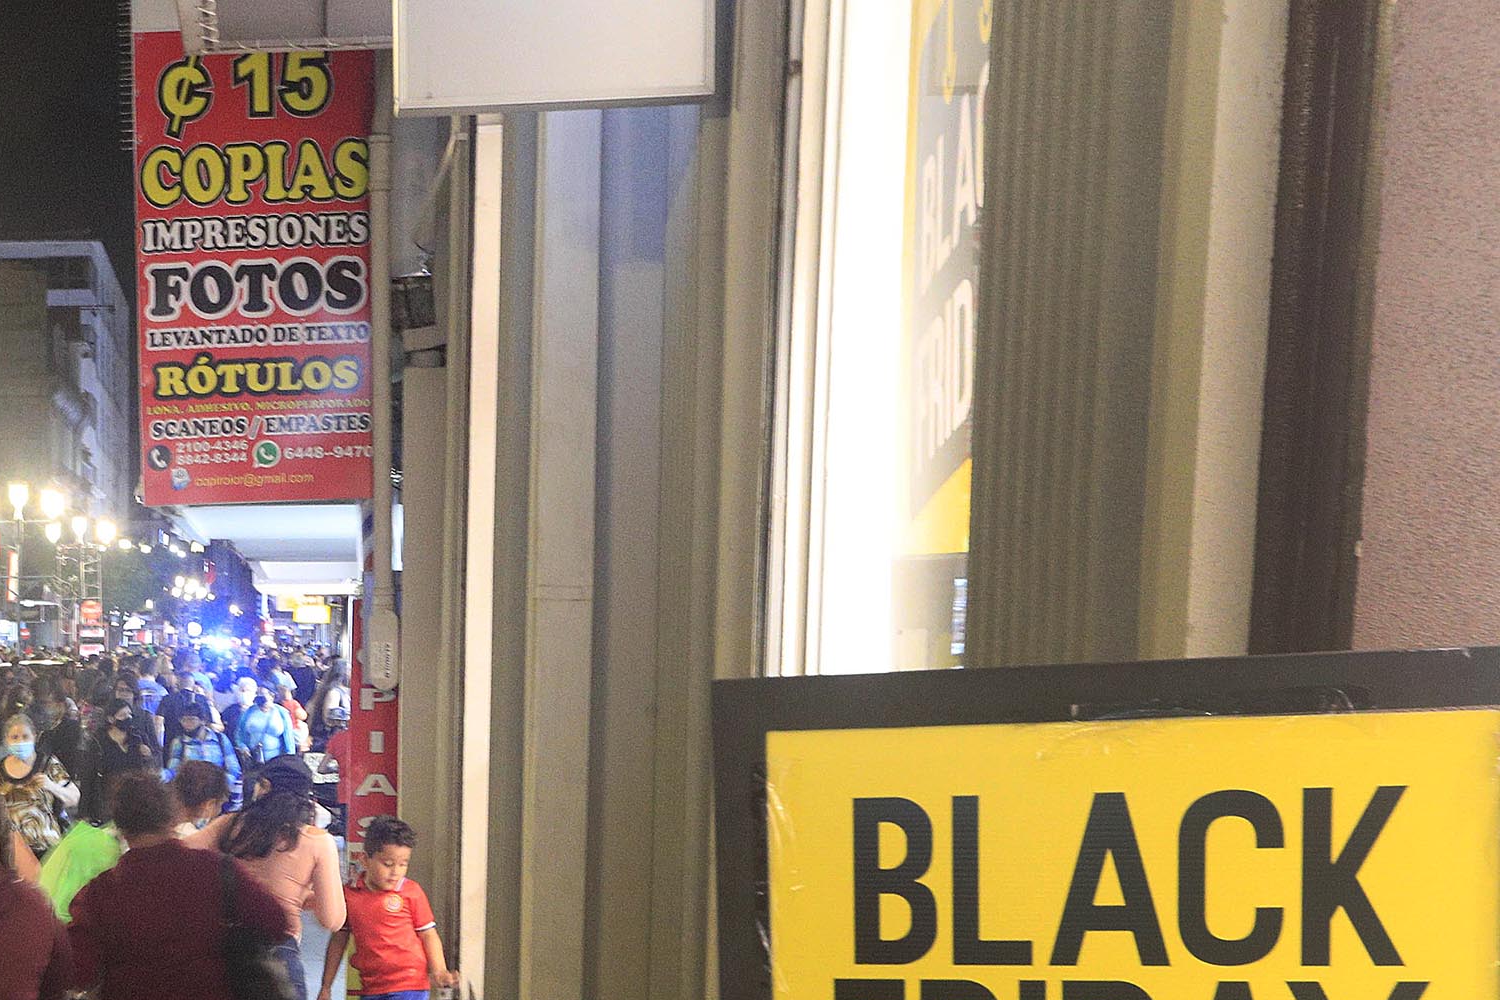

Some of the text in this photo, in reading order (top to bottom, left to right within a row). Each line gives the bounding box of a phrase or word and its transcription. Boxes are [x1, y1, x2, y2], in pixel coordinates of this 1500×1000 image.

[233, 50, 334, 119] 15
[141, 138, 370, 208] COPIAS
[917, 60, 989, 297] BLA
[142, 211, 370, 253] IMPRESIONES
[146, 256, 368, 321] FOTOS
[147, 321, 370, 349] LEVANTADO DE TEXTO
[155, 352, 361, 399] RÓTULOS
[916, 278, 974, 486] FRID
[152, 418, 248, 440] SCANEOS
[264, 413, 372, 435] EMPASTES
[853, 785, 1408, 967] BLACK
